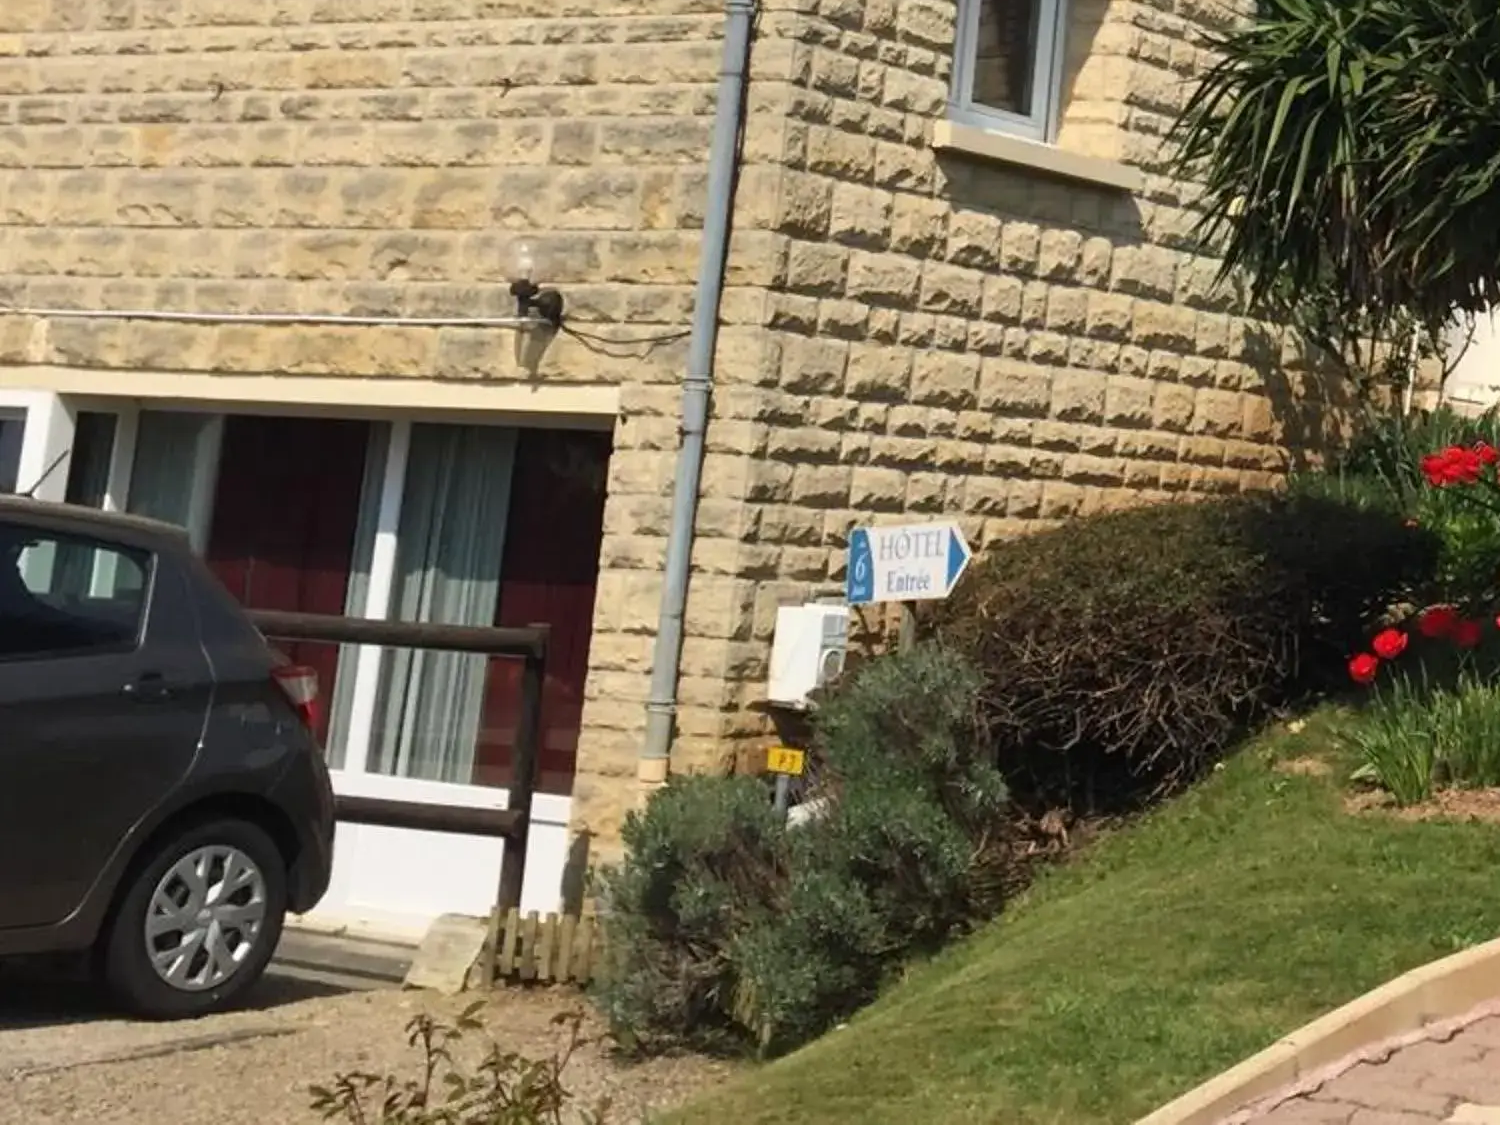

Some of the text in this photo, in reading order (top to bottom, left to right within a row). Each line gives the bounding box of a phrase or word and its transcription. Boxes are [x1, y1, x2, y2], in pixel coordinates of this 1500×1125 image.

[880, 528, 943, 561] HÔTEL
[855, 550, 869, 584] 6
[886, 568, 931, 593] Entrée
